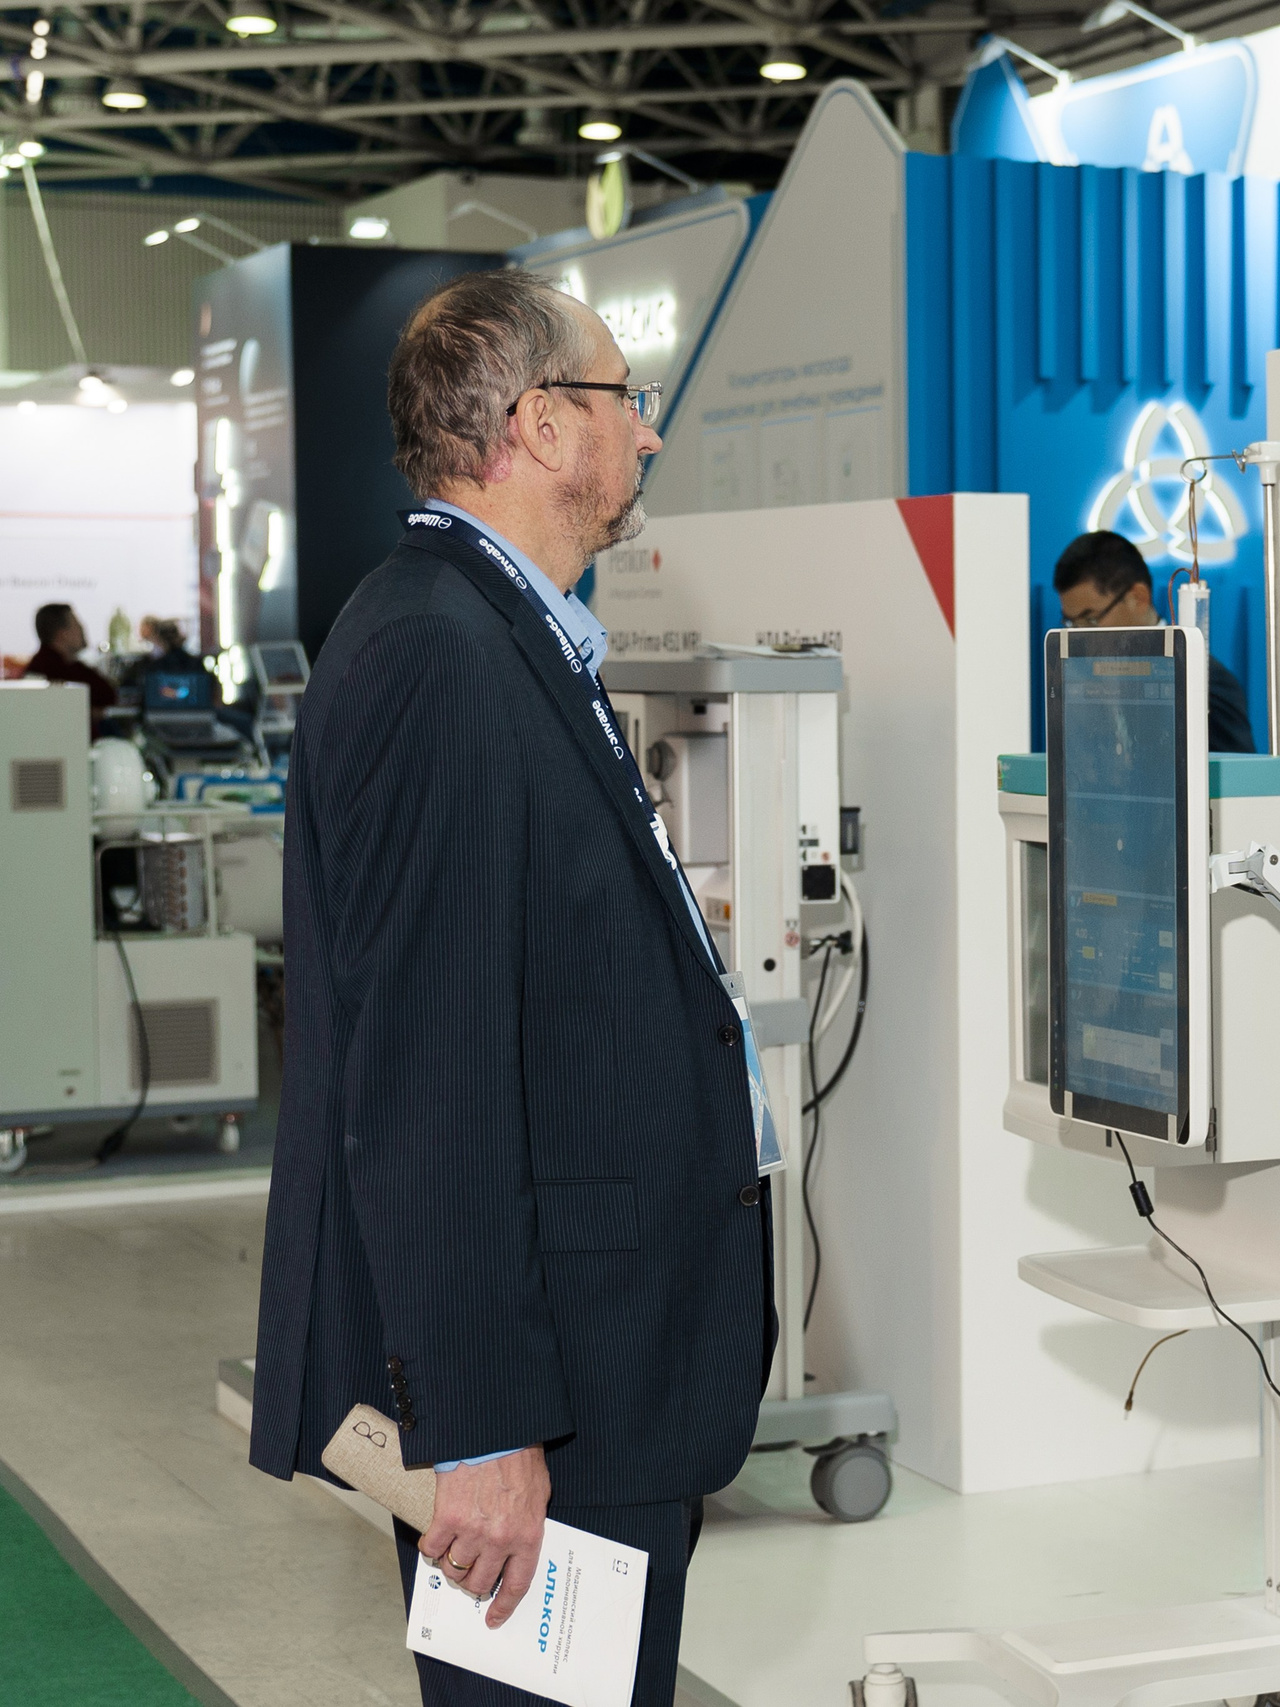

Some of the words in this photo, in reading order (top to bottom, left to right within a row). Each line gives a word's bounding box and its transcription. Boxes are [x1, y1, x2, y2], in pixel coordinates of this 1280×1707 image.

[407, 513, 441, 527] Швабе
[478, 537, 519, 578] Shvabe
[545, 613, 576, 661] Швабе
[567, 1549, 575, 1566] для
[538, 1559, 557, 1654] АЛЬКОР
[559, 1568, 572, 1635] малоинвазивной
[570, 1567, 581, 1623] Медицинский
[552, 1636, 564, 1675] хирургии
[563, 1625, 575, 1663] комплекс
